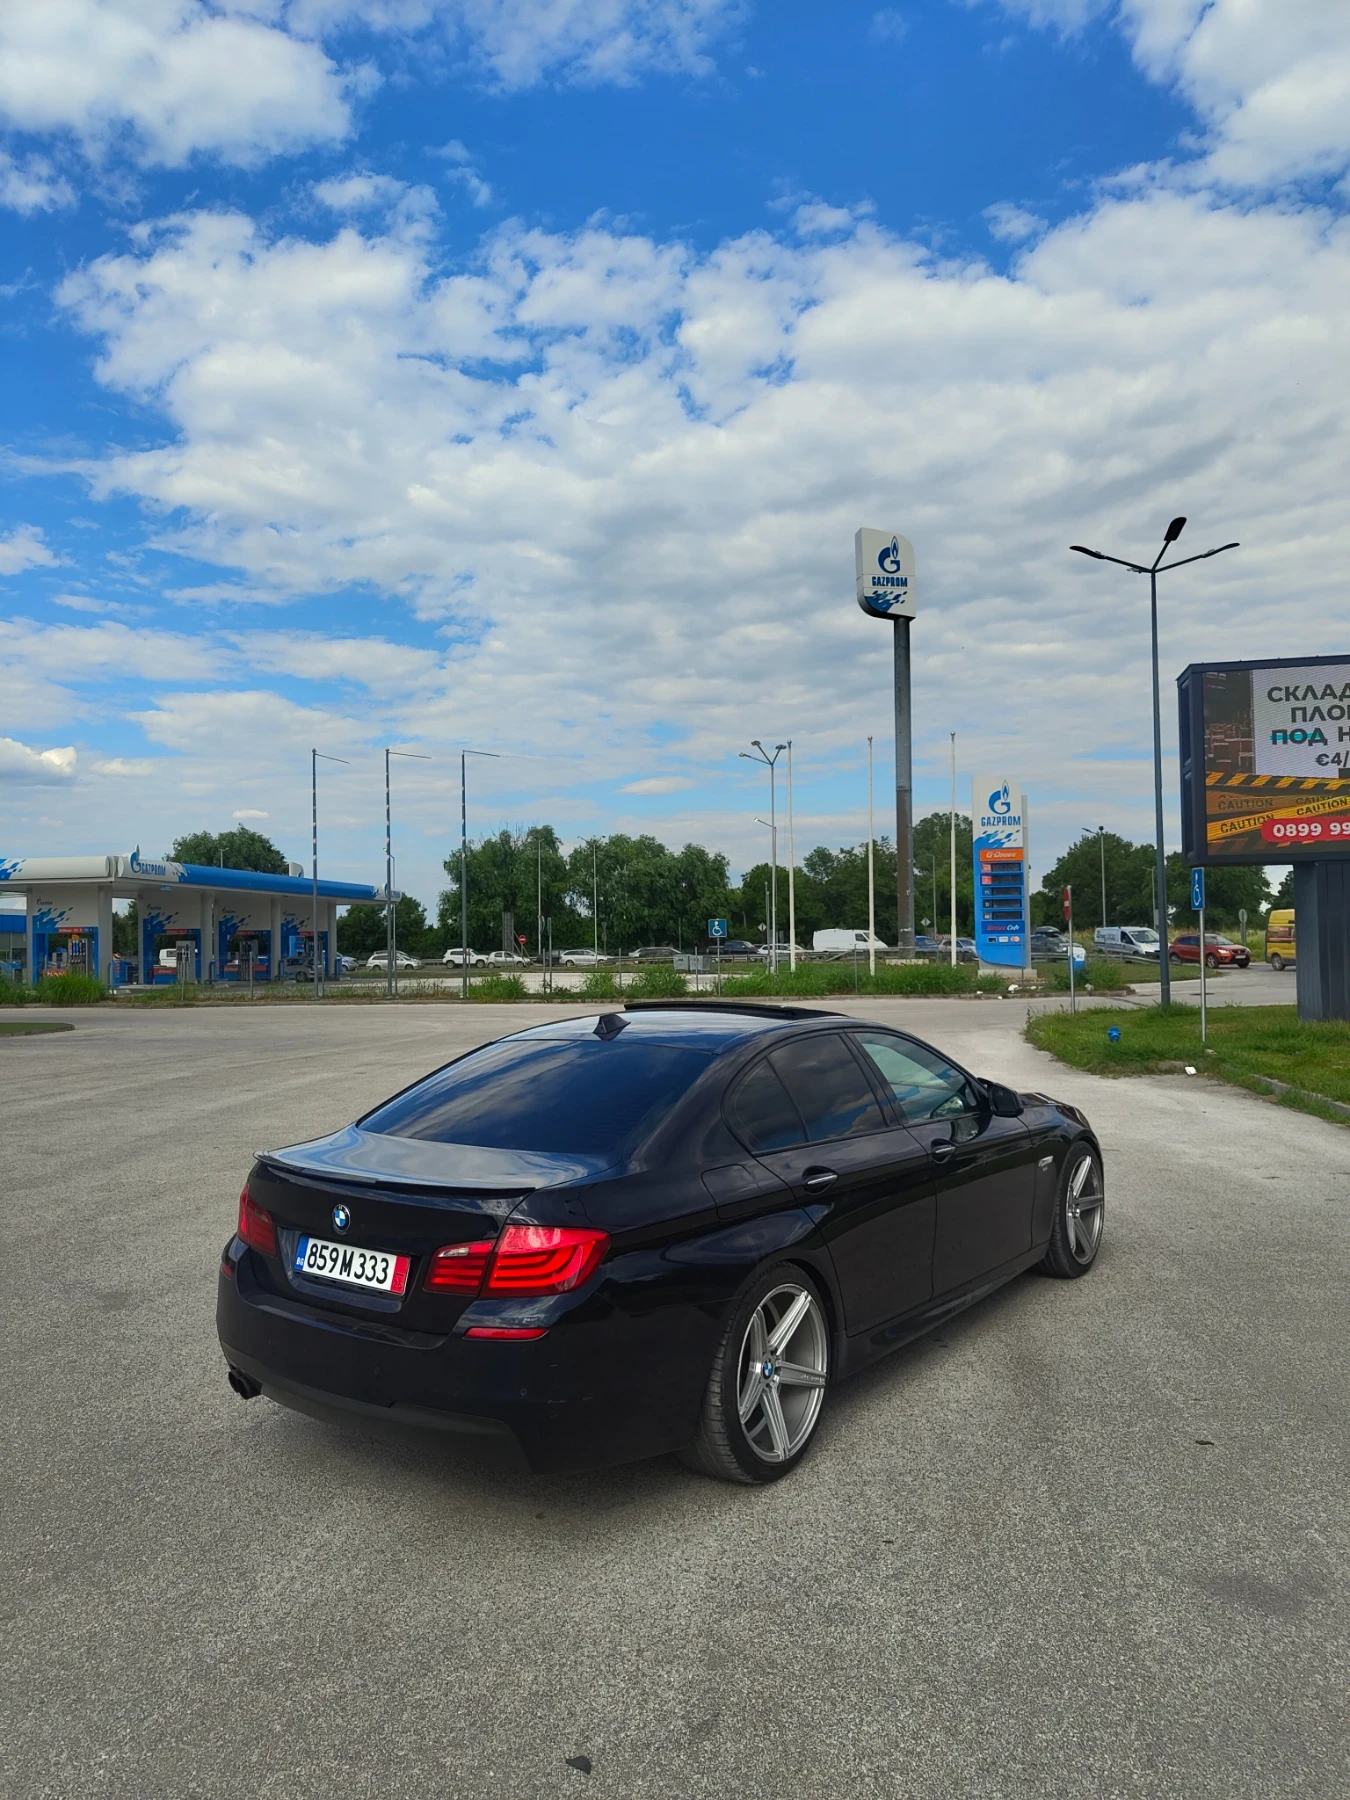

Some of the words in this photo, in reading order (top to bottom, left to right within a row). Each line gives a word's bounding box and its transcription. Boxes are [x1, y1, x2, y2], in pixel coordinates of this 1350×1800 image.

[872, 576, 908, 588] GAZPROM
[1291, 705, 1350, 723] ПЛО
[1271, 728, 1328, 746] ПОД
[1218, 799, 1273, 810] CAUTION
[1297, 798, 1348, 815] CAUTION
[981, 816, 1021, 827] GAZPROM
[1273, 823, 1322, 837] 0899
